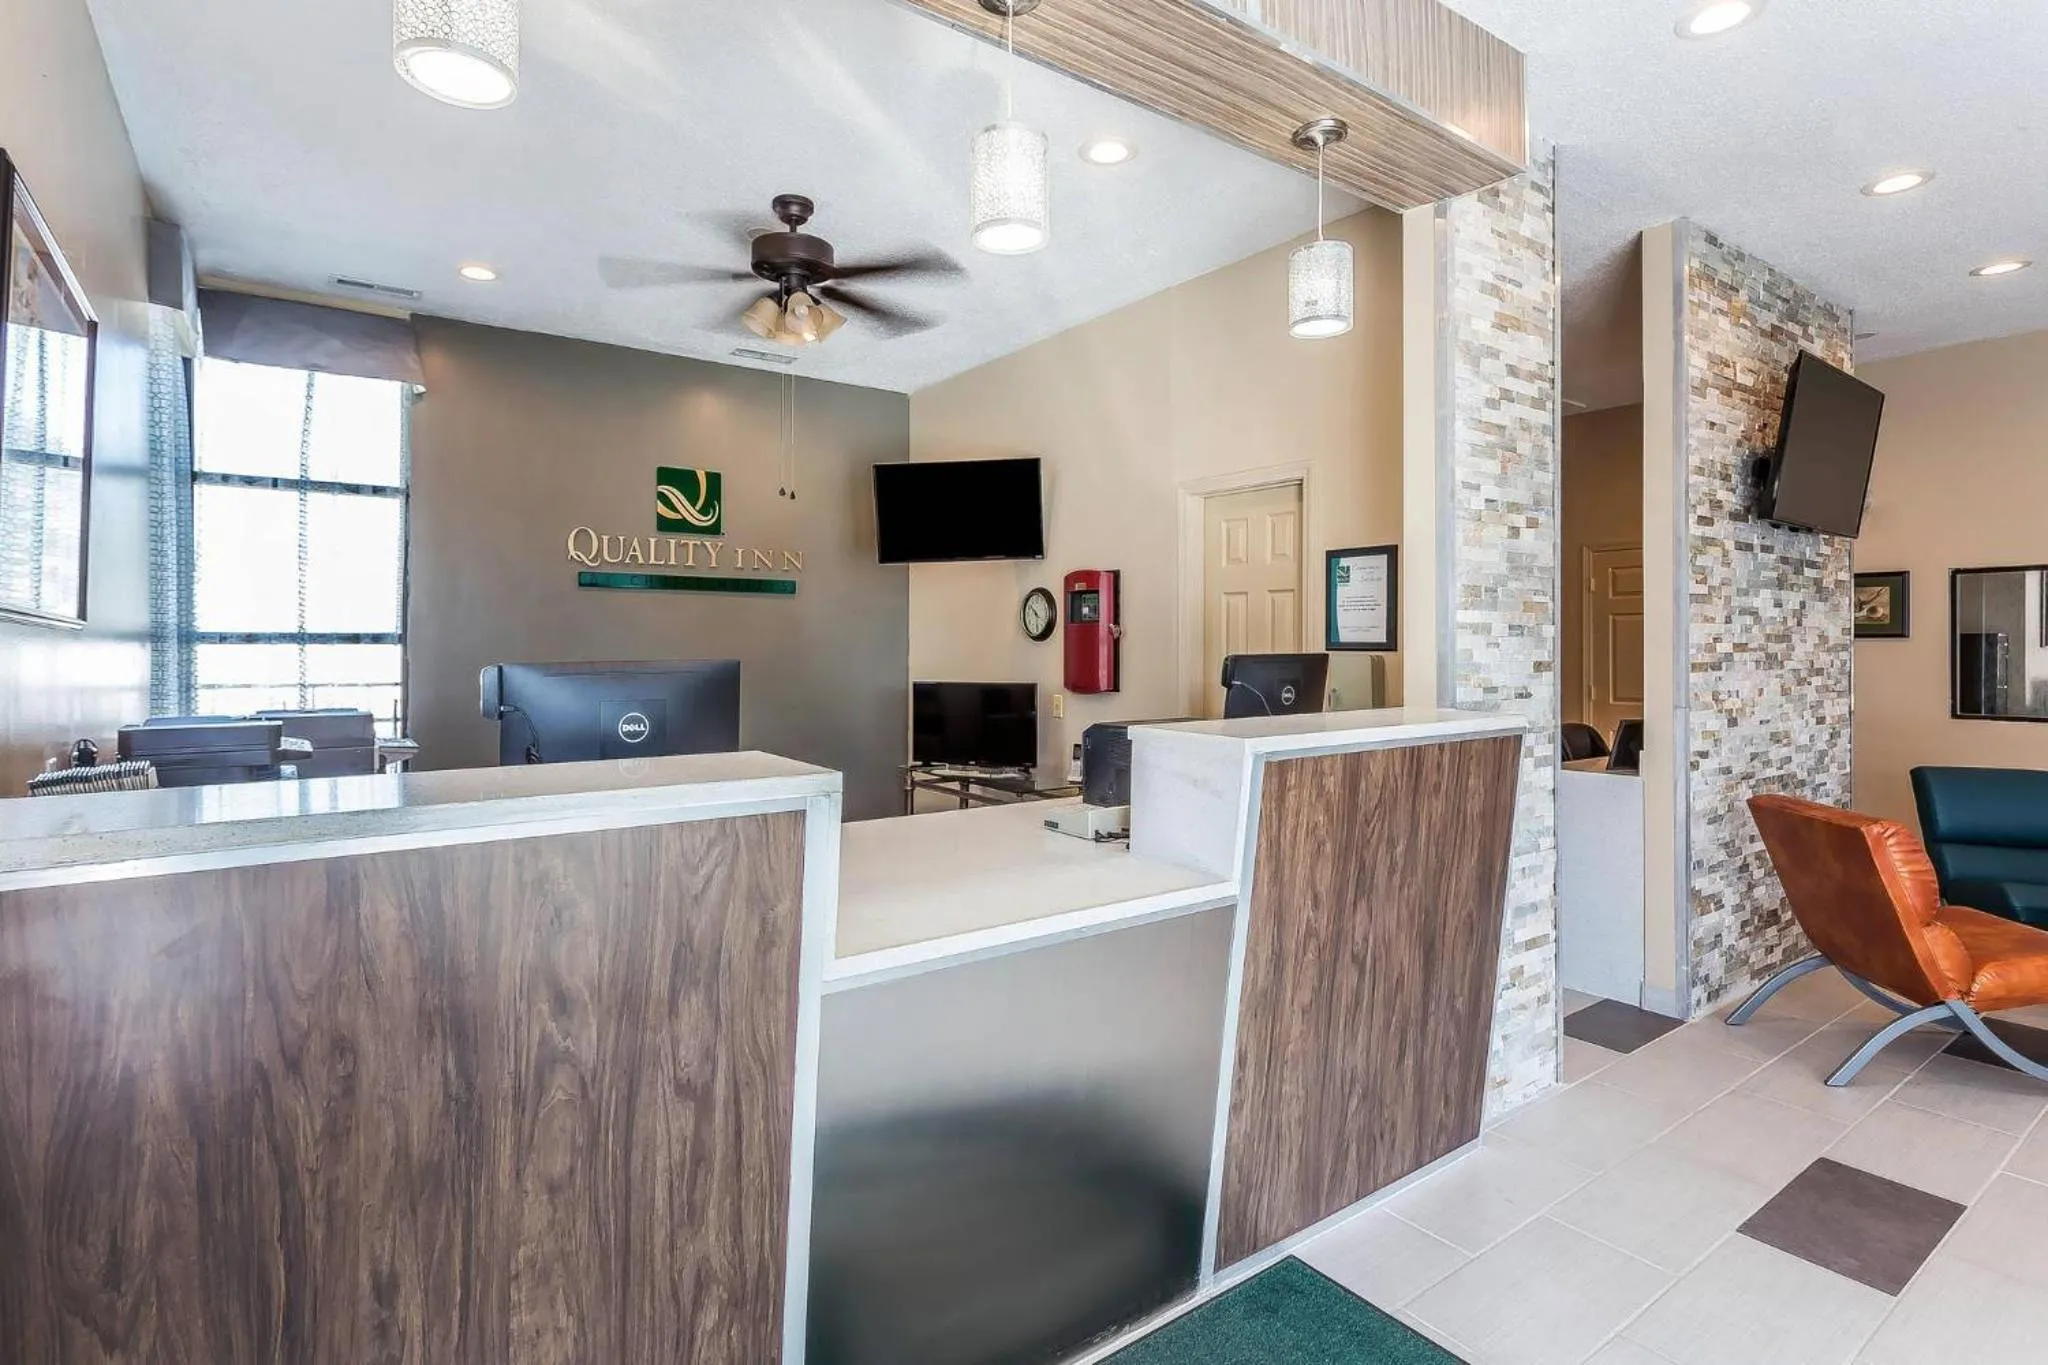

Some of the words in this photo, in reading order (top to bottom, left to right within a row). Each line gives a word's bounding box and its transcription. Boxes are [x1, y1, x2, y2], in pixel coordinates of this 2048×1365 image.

[567, 526, 723, 568] QUALITY
[735, 548, 804, 571] INN
[622, 723, 646, 732] DELL
